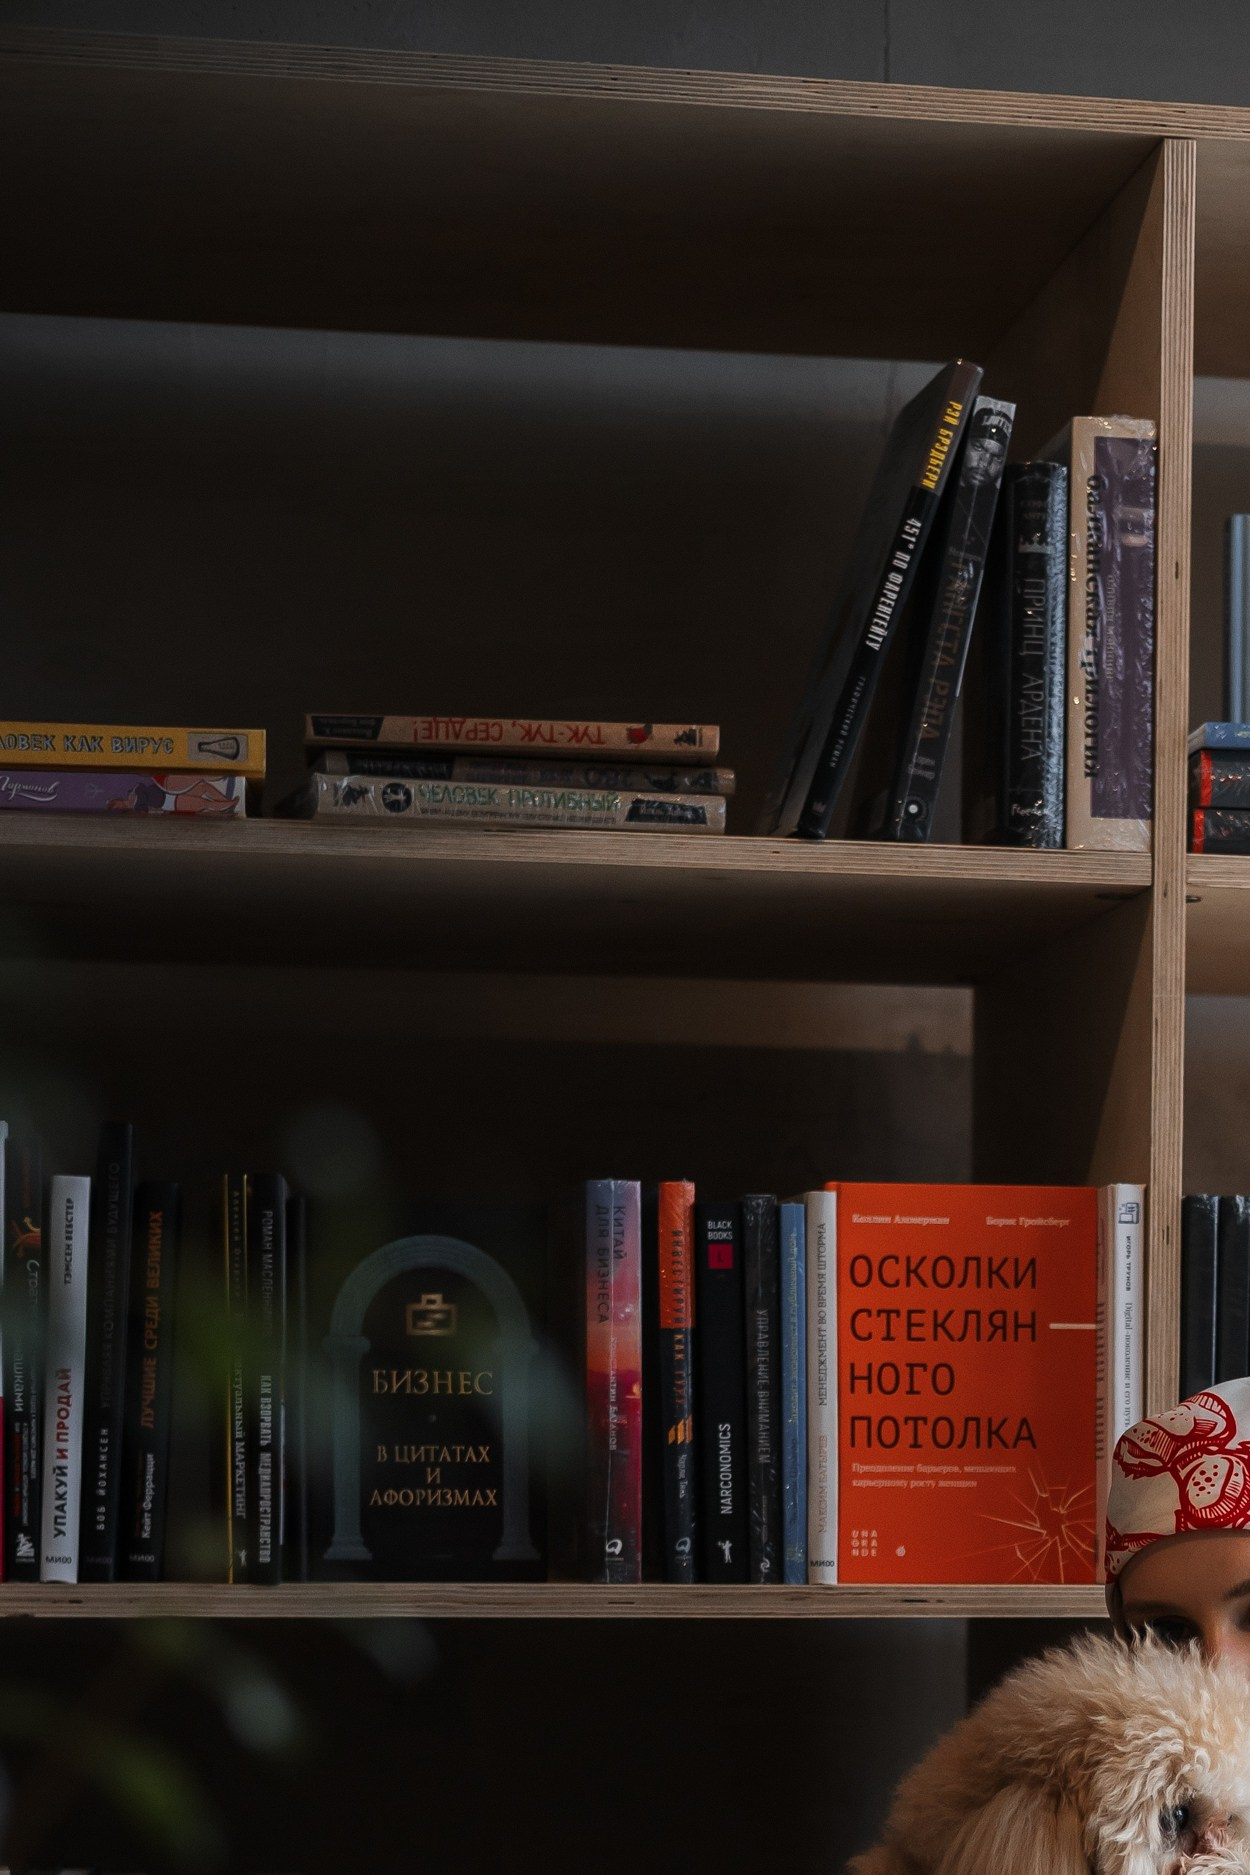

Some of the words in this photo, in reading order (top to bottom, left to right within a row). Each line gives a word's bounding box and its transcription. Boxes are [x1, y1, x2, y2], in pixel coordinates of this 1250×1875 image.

[919, 428, 953, 489] БРЭДБЕРИ
[899, 517, 922, 549] 451°
[892, 551, 911, 569] ПО
[863, 572, 905, 651] ФАРЕНГЕЙТУ
[1017, 579, 1044, 656] ПРИНЦ
[412, 716, 503, 742] СЕРДЦЕ!
[510, 720, 604, 744] ТУК-ТУК,
[1018, 672, 1044, 760] АРДЕНА
[64, 735, 105, 753] КАК
[112, 737, 175, 754] ВИРУС
[260, 1210, 272, 1250] РОМАН
[594, 1205, 609, 1243] ДЛЯ
[707, 1219, 733, 1229] BLACK
[707, 1230, 733, 1240] BOOKS
[145, 1210, 164, 1288] ВЕЛИКИХ
[816, 1222, 827, 1269] ШТОРМА
[596, 1247, 609, 1324] БИЗНЕСА
[817, 1271, 827, 1307] ВРЕМЯ
[849, 1254, 1038, 1290] ОСКОЛКИ
[143, 1295, 160, 1349] СРЕДИ
[817, 1309, 827, 1324] ВО
[849, 1307, 1037, 1343] СТЕКЛЯН
[672, 1334, 684, 1361] КАК
[754, 1309, 768, 1385] УПРАВЛЕНИЕ
[372, 1370, 493, 1396] БИЗНЕС
[816, 1326, 828, 1405] МЕНЕДЖМЕНТ
[849, 1362, 955, 1396] НОГО
[140, 1356, 157, 1427] ЛУЧШИЕ
[258, 1375, 270, 1395] КАК
[55, 1367, 71, 1442] ПРОДАЙ
[258, 1397, 270, 1446] ВЗОРВАТЬ
[756, 1390, 770, 1464] ВНИМАНИЕМ
[849, 1416, 1037, 1450] ПОТОЛКА
[57, 1448, 70, 1458] И
[95, 1426, 110, 1495] ЙОХАНСЕН
[377, 1446, 388, 1463] В
[395, 1446, 491, 1467] ЦИТАТАХ
[717, 1423, 731, 1515] NARCONOMICS
[233, 1441, 246, 1519] МАРКЕТИНГ
[426, 1467, 441, 1485] И
[53, 1464, 70, 1537] УПАКУЙ
[257, 1452, 271, 1563] МЕДИАПРОСТРАНСТВО
[369, 1488, 498, 1508] АФОРИЗМАХ
[96, 1504, 107, 1530] БОБ
[141, 1512, 154, 1538] Кейт
